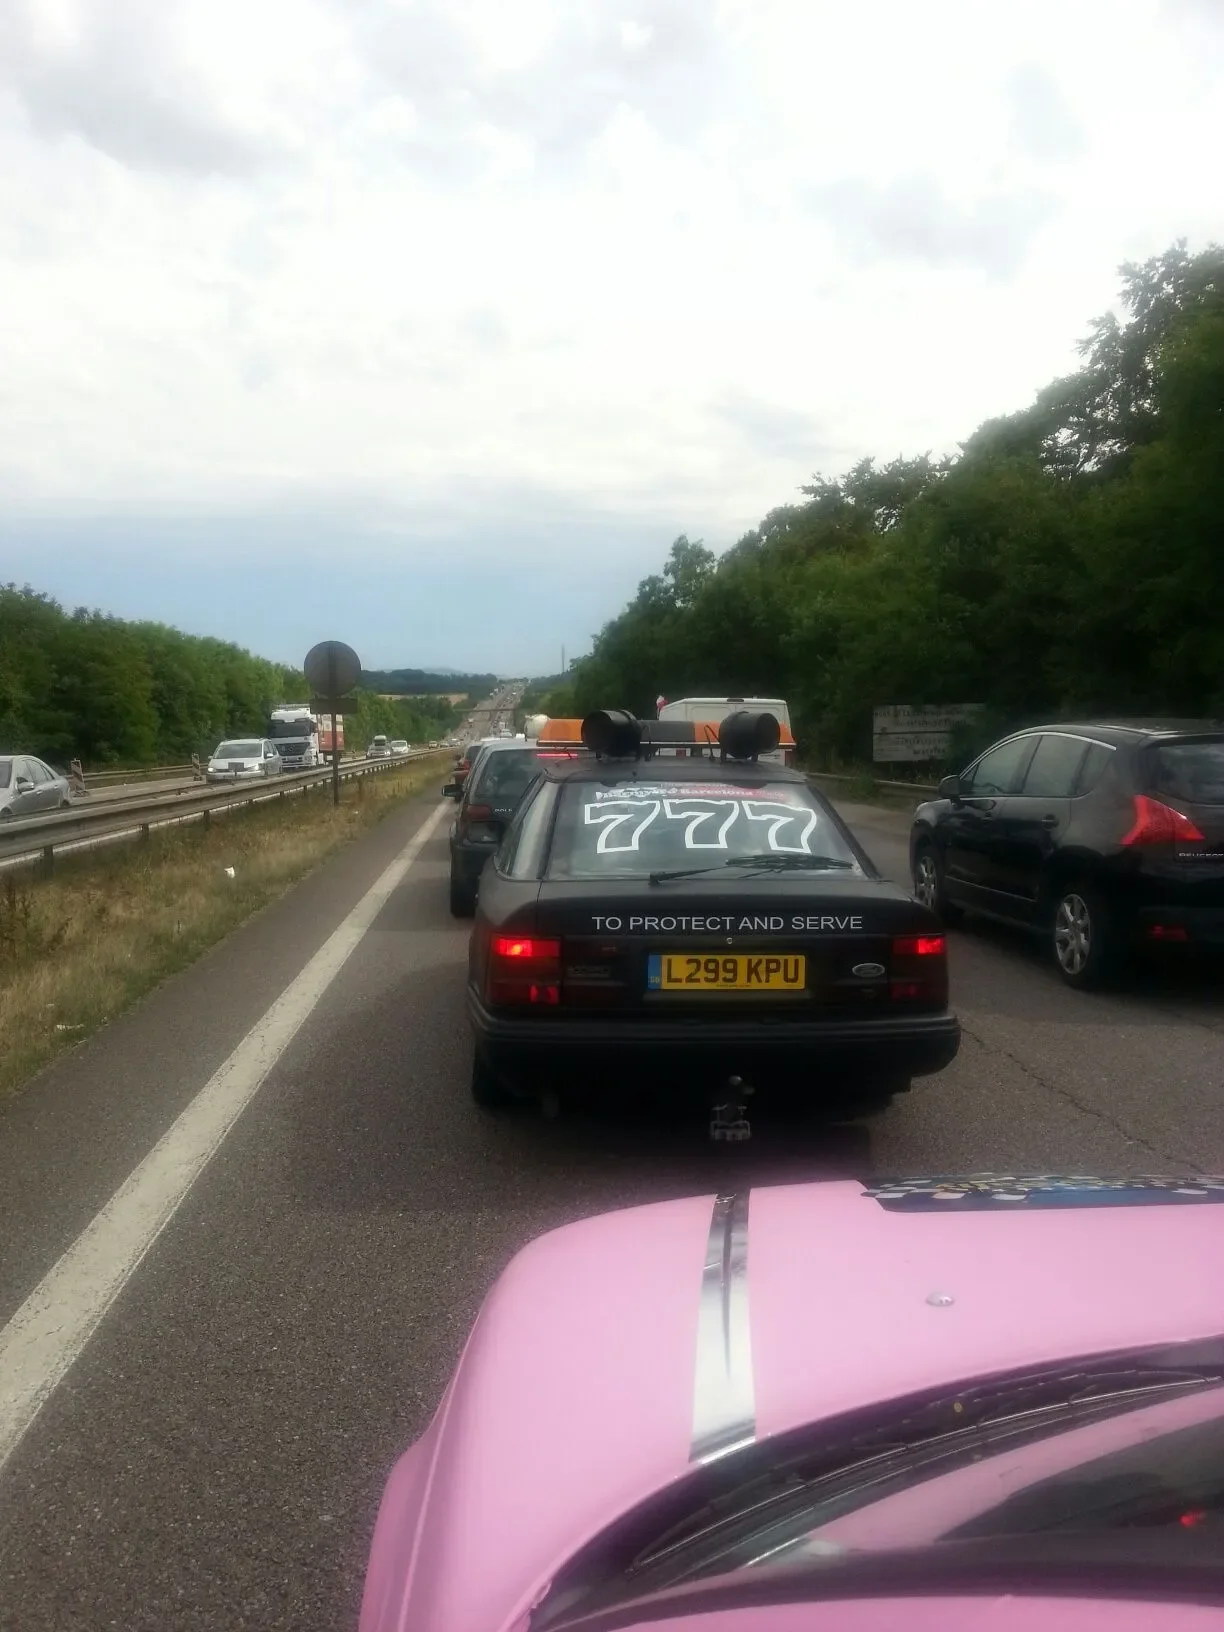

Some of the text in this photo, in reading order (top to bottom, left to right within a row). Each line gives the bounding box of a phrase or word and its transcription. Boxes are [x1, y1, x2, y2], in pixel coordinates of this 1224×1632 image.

[584, 799, 817, 854] 777
[592, 916, 863, 930] TO PROTECT AND SERVE
[666, 958, 799, 983] L299 KPU
